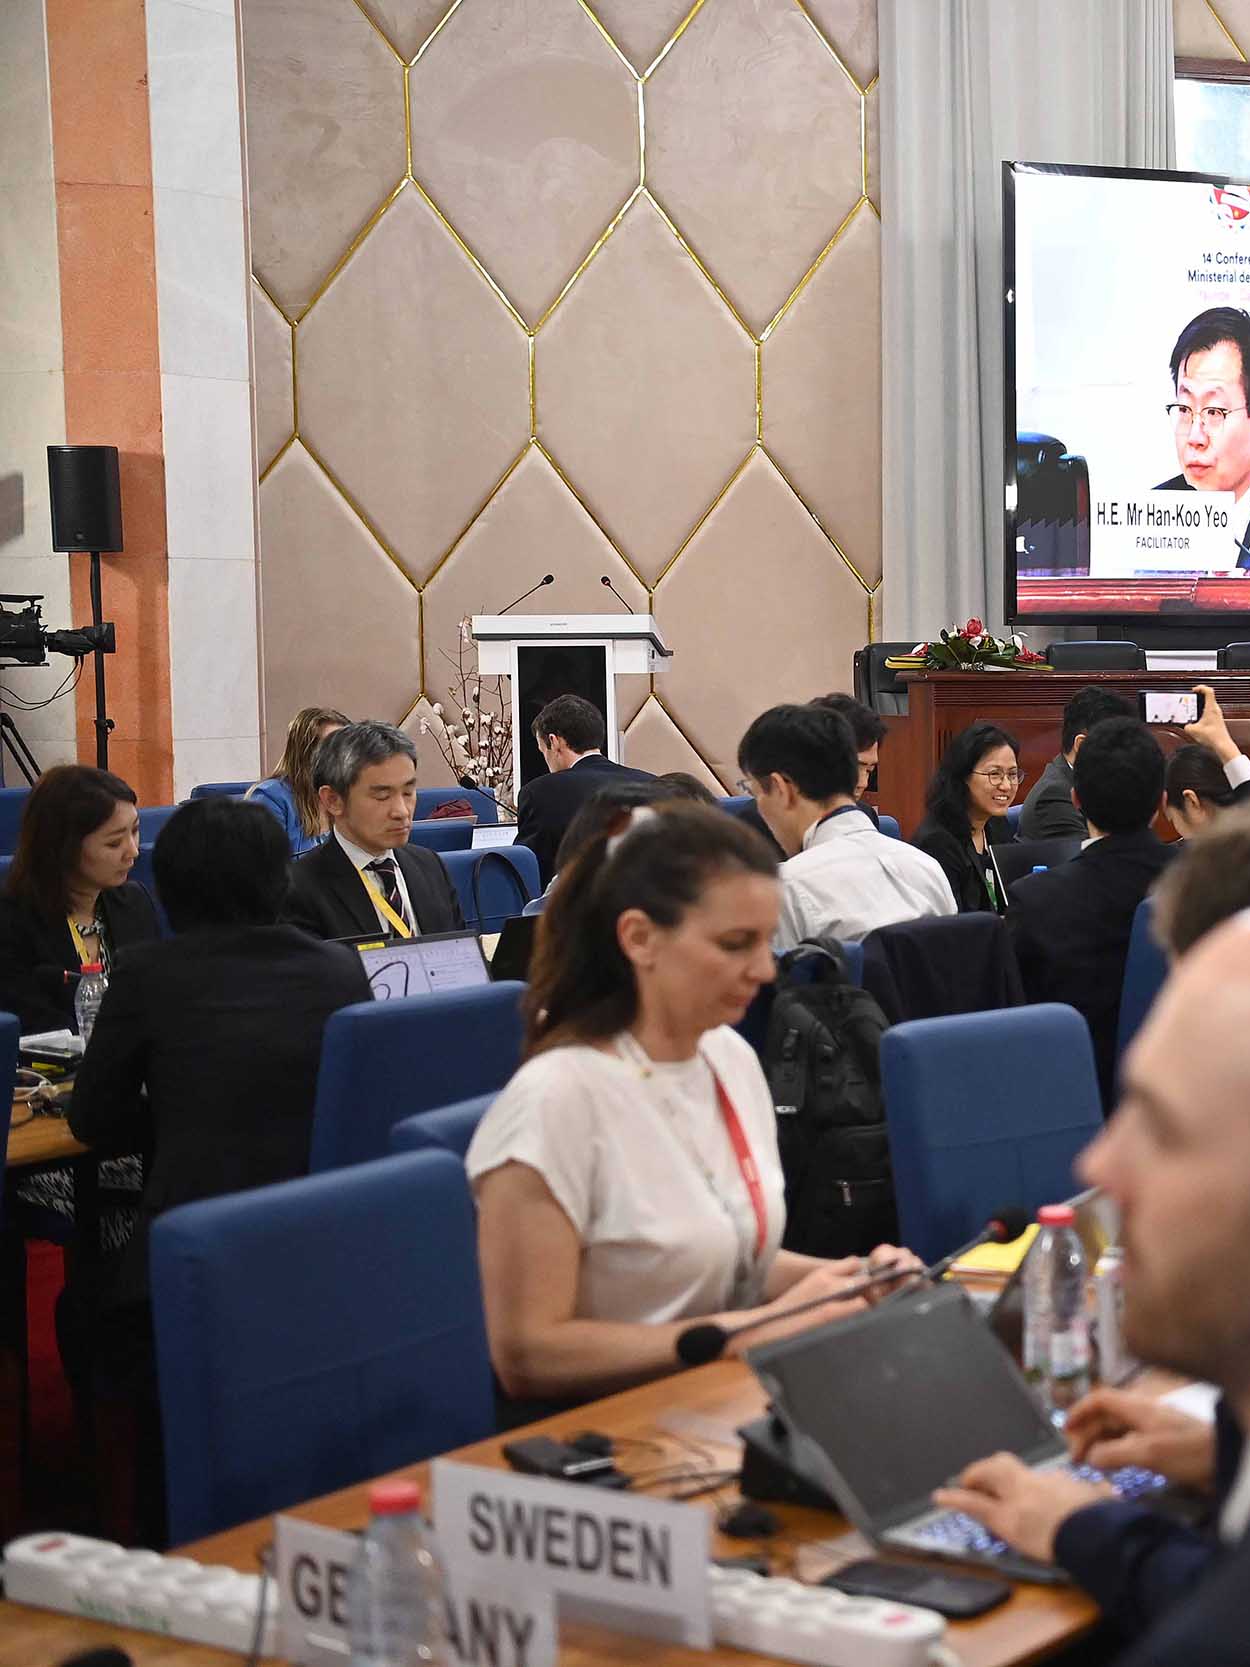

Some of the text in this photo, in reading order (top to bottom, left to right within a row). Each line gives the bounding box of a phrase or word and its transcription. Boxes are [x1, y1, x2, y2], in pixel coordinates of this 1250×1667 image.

[1203, 253, 1212, 264] 14
[1188, 269, 1237, 283] Ministerial
[1239, 270, 1250, 283] de
[1097, 502, 1228, 528] H.E. Mr Han-Koo Yeo
[1136, 536, 1190, 549] FACILITATOR
[468, 1492, 673, 1589] SWEDEN
